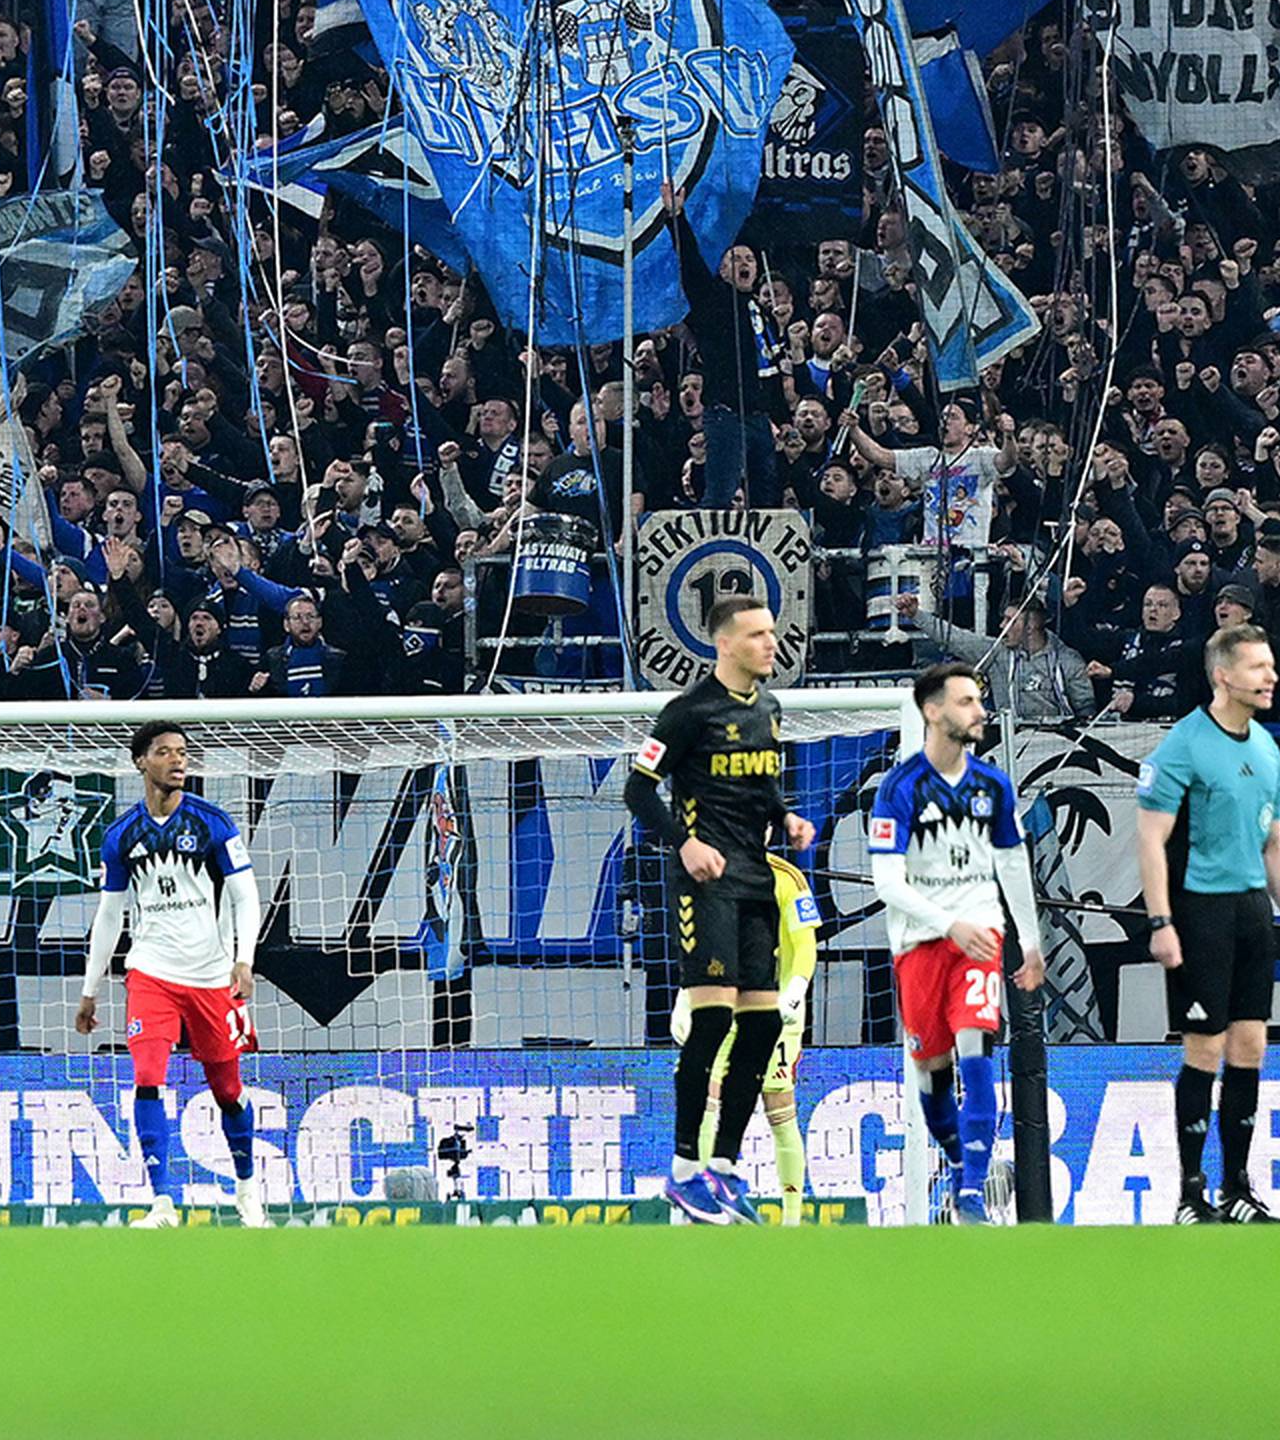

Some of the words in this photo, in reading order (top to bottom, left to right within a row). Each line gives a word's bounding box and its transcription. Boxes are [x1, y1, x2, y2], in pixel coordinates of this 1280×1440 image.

[760, 142, 852, 183] ltras
[637, 511, 773, 578] SEKTION
[773, 524, 812, 574] 12
[710, 750, 777, 777] REWE
[965, 969, 1001, 1006] 20
[777, 1041, 788, 1067] 1
